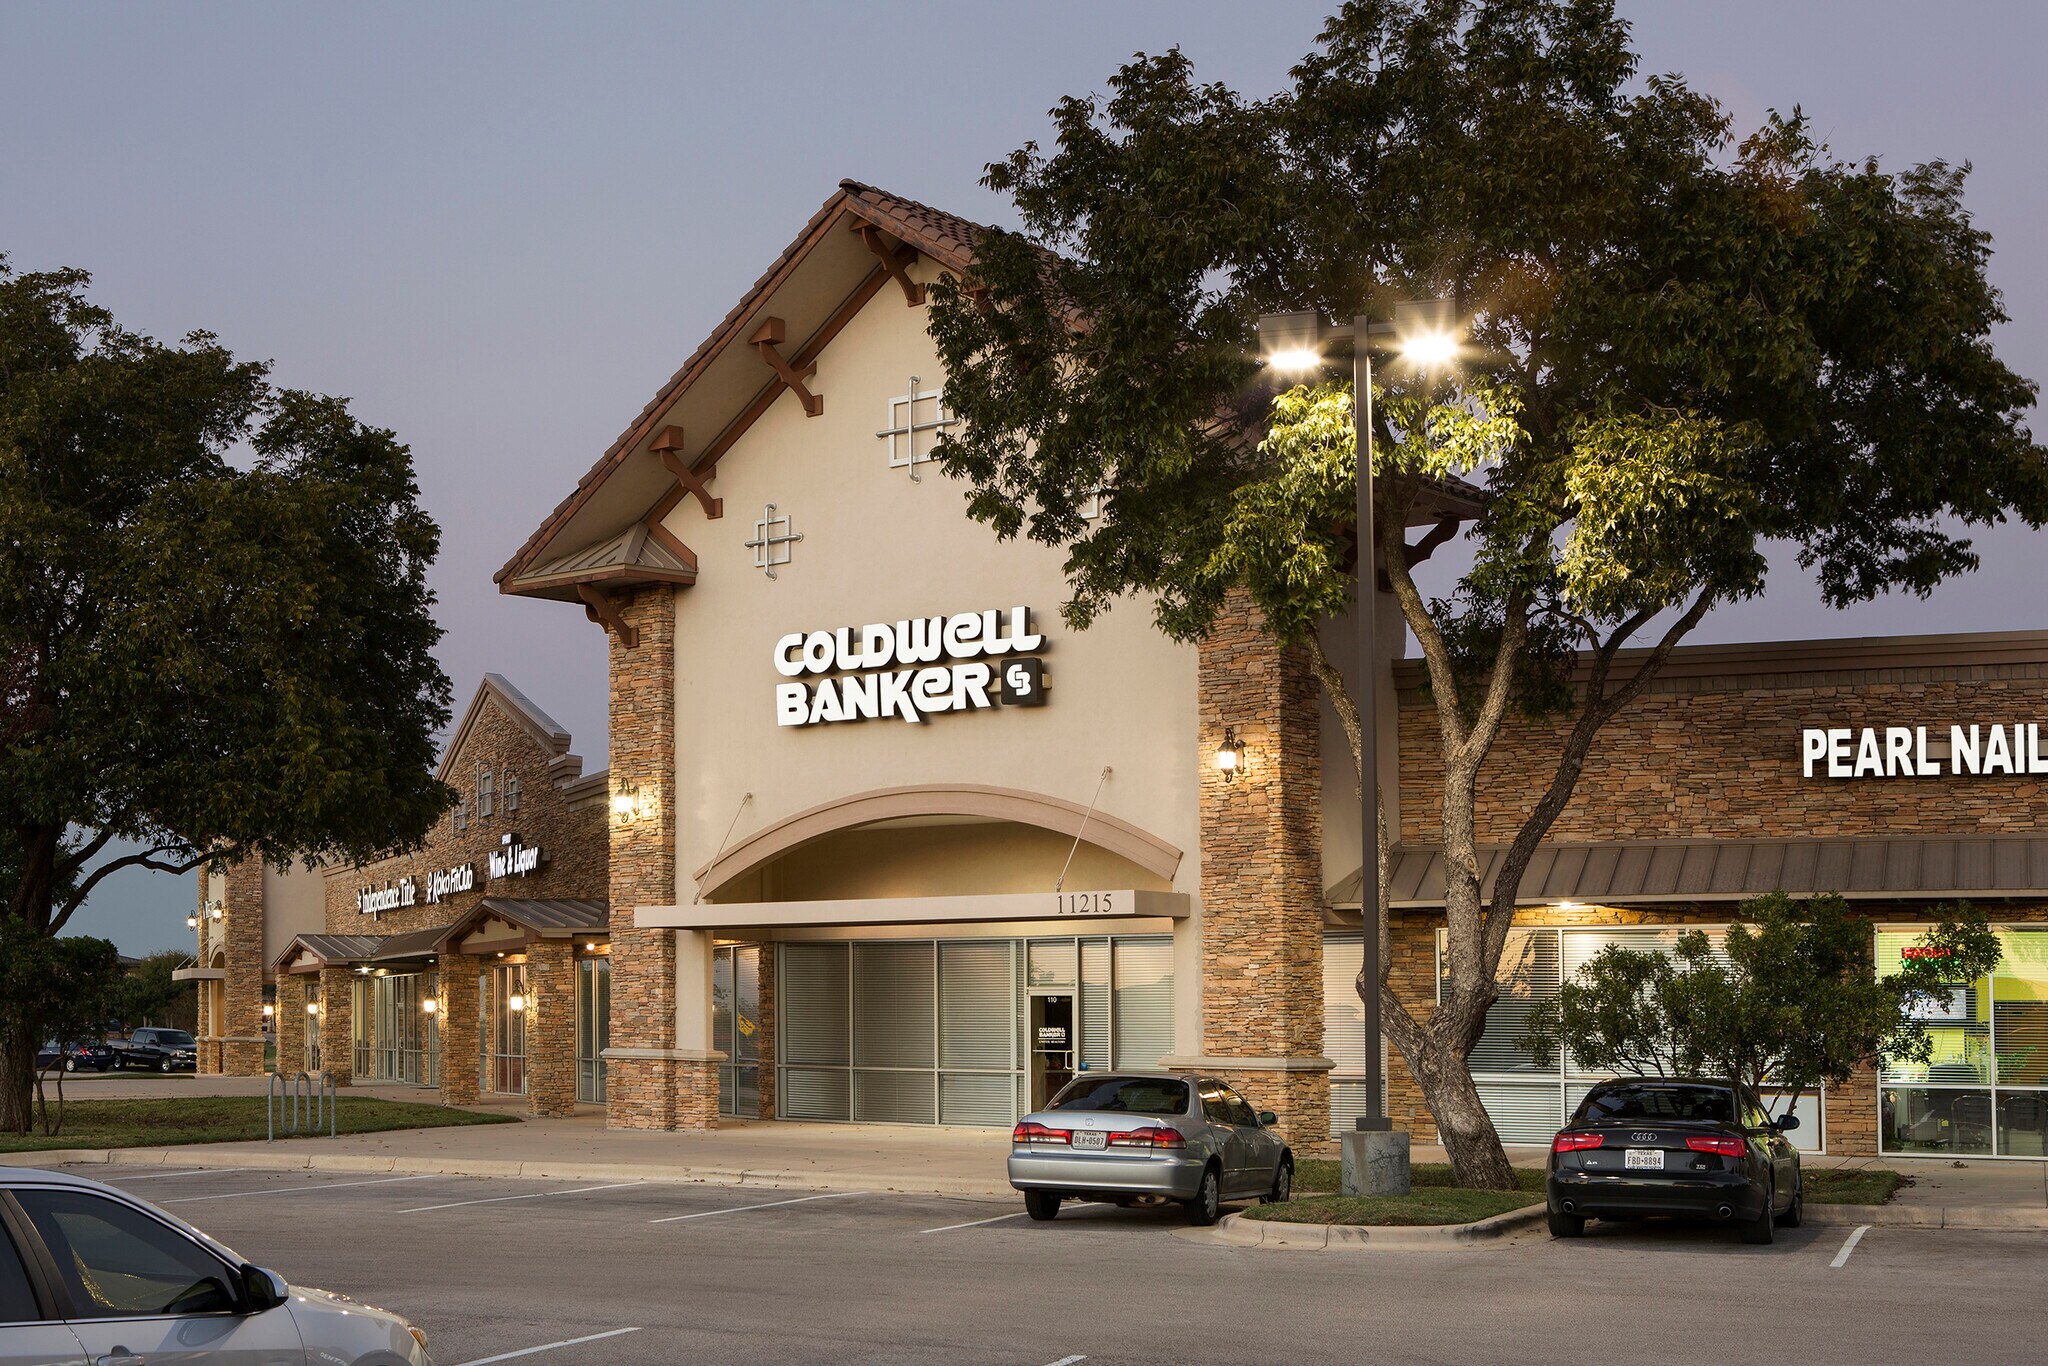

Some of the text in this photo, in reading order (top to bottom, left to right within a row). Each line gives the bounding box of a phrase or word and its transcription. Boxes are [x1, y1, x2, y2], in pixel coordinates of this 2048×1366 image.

[774, 606, 1043, 676] COLDWELL
[776, 663, 991, 726] BANKER
[1803, 723, 2048, 778] PEARL NAIL
[489, 844, 538, 879] Wine & Liquor
[362, 875, 415, 921] Independence Title
[1057, 893, 1112, 914] 11215
